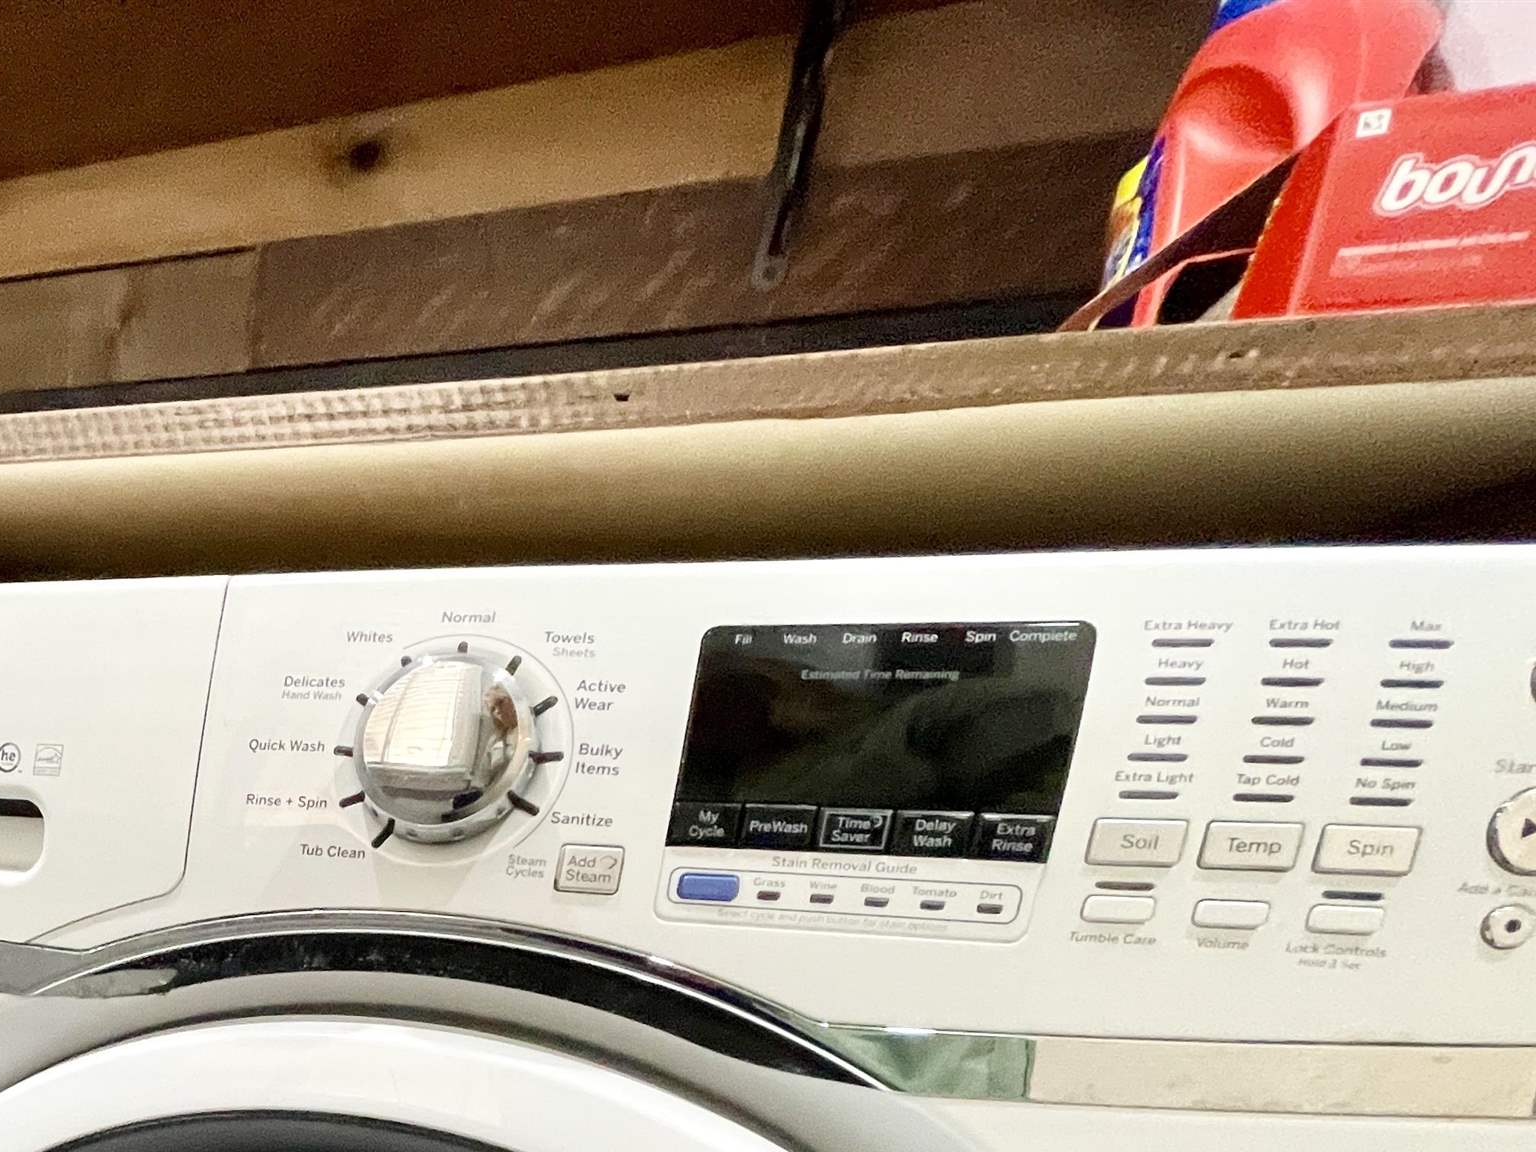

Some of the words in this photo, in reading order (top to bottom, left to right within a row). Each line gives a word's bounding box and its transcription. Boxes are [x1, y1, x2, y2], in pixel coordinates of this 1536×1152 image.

[1374, 142, 1536, 215] boun
[441, 611, 496, 624] Normal
[1144, 619, 1182, 632] Extra
[1186, 619, 1234, 633] Heavy
[1269, 619, 1309, 631] Extra
[1313, 619, 1341, 631] Hot
[1410, 620, 1443, 632] Max
[346, 631, 393, 643] Whites
[544, 631, 595, 645] Towels
[735, 633, 753, 645] Fill
[783, 633, 817, 645] Wash
[842, 632, 877, 645] Drain
[901, 631, 938, 644] Rinse
[966, 631, 997, 645] Spin
[1009, 630, 1078, 645] Complete
[552, 646, 595, 658] Sheets
[1157, 658, 1203, 671] Heavy
[1282, 658, 1310, 670] Hot
[1398, 660, 1435, 673] High
[284, 676, 346, 688] Delicates
[800, 669, 861, 680] Estimated
[863, 669, 892, 680] Time
[895, 669, 960, 681] Remaining
[576, 680, 627, 694] Active
[281, 689, 307, 700] Hand
[310, 690, 343, 701] Wash
[1145, 696, 1200, 708] Normal
[574, 698, 614, 711] Wear
[1265, 698, 1310, 710] Warm
[1376, 700, 1438, 713] Medium
[248, 739, 286, 753] Quick
[290, 739, 326, 752] Wash
[1144, 734, 1182, 747] Light
[1260, 736, 1295, 748] Cold
[1381, 740, 1412, 752] Low
[1, 750, 16, 762] he
[579, 743, 624, 759] Bulky
[575, 762, 621, 776] Items
[1114, 771, 1152, 784] Extra
[1156, 771, 1194, 785] Light
[1236, 773, 1262, 787] Tap
[1266, 773, 1300, 786] Cold
[1354, 778, 1377, 790] No
[1382, 778, 1416, 793] Spin
[246, 793, 282, 807] Rinse
[285, 797, 295, 807] +
[297, 795, 328, 811] Spin
[551, 812, 614, 827] Sanitize
[699, 811, 720, 825] My
[837, 816, 871, 830] Time
[688, 824, 726, 839] Cycle
[749, 820, 809, 834] PreWash
[915, 818, 956, 833] Delay
[997, 823, 1036, 837] Extra
[831, 830, 871, 843] Saver
[913, 834, 953, 847] Wash
[1121, 834, 1160, 850] Soil
[300, 844, 324, 857] Tub
[327, 846, 366, 859] Clean
[992, 838, 1033, 853] Rinse
[1228, 837, 1282, 855] Temp
[1347, 840, 1394, 859] Spin
[507, 855, 547, 867] Steam
[567, 855, 596, 868] Add
[772, 856, 808, 869] Stain
[812, 858, 872, 872] Removal
[875, 860, 918, 875] Guide
[505, 866, 545, 880] Cycles
[566, 870, 612, 884] Steam
[752, 876, 786, 889] Grass
[810, 881, 838, 891] Wine
[861, 883, 895, 895] Blood
[912, 886, 957, 898] Tomato
[980, 890, 1003, 901] Dirt
[1069, 931, 1118, 945] Tumble
[1122, 933, 1157, 946] Care
[1196, 936, 1249, 951] Volume
[1285, 941, 1321, 955] Lock
[1323, 943, 1386, 958] Controls
